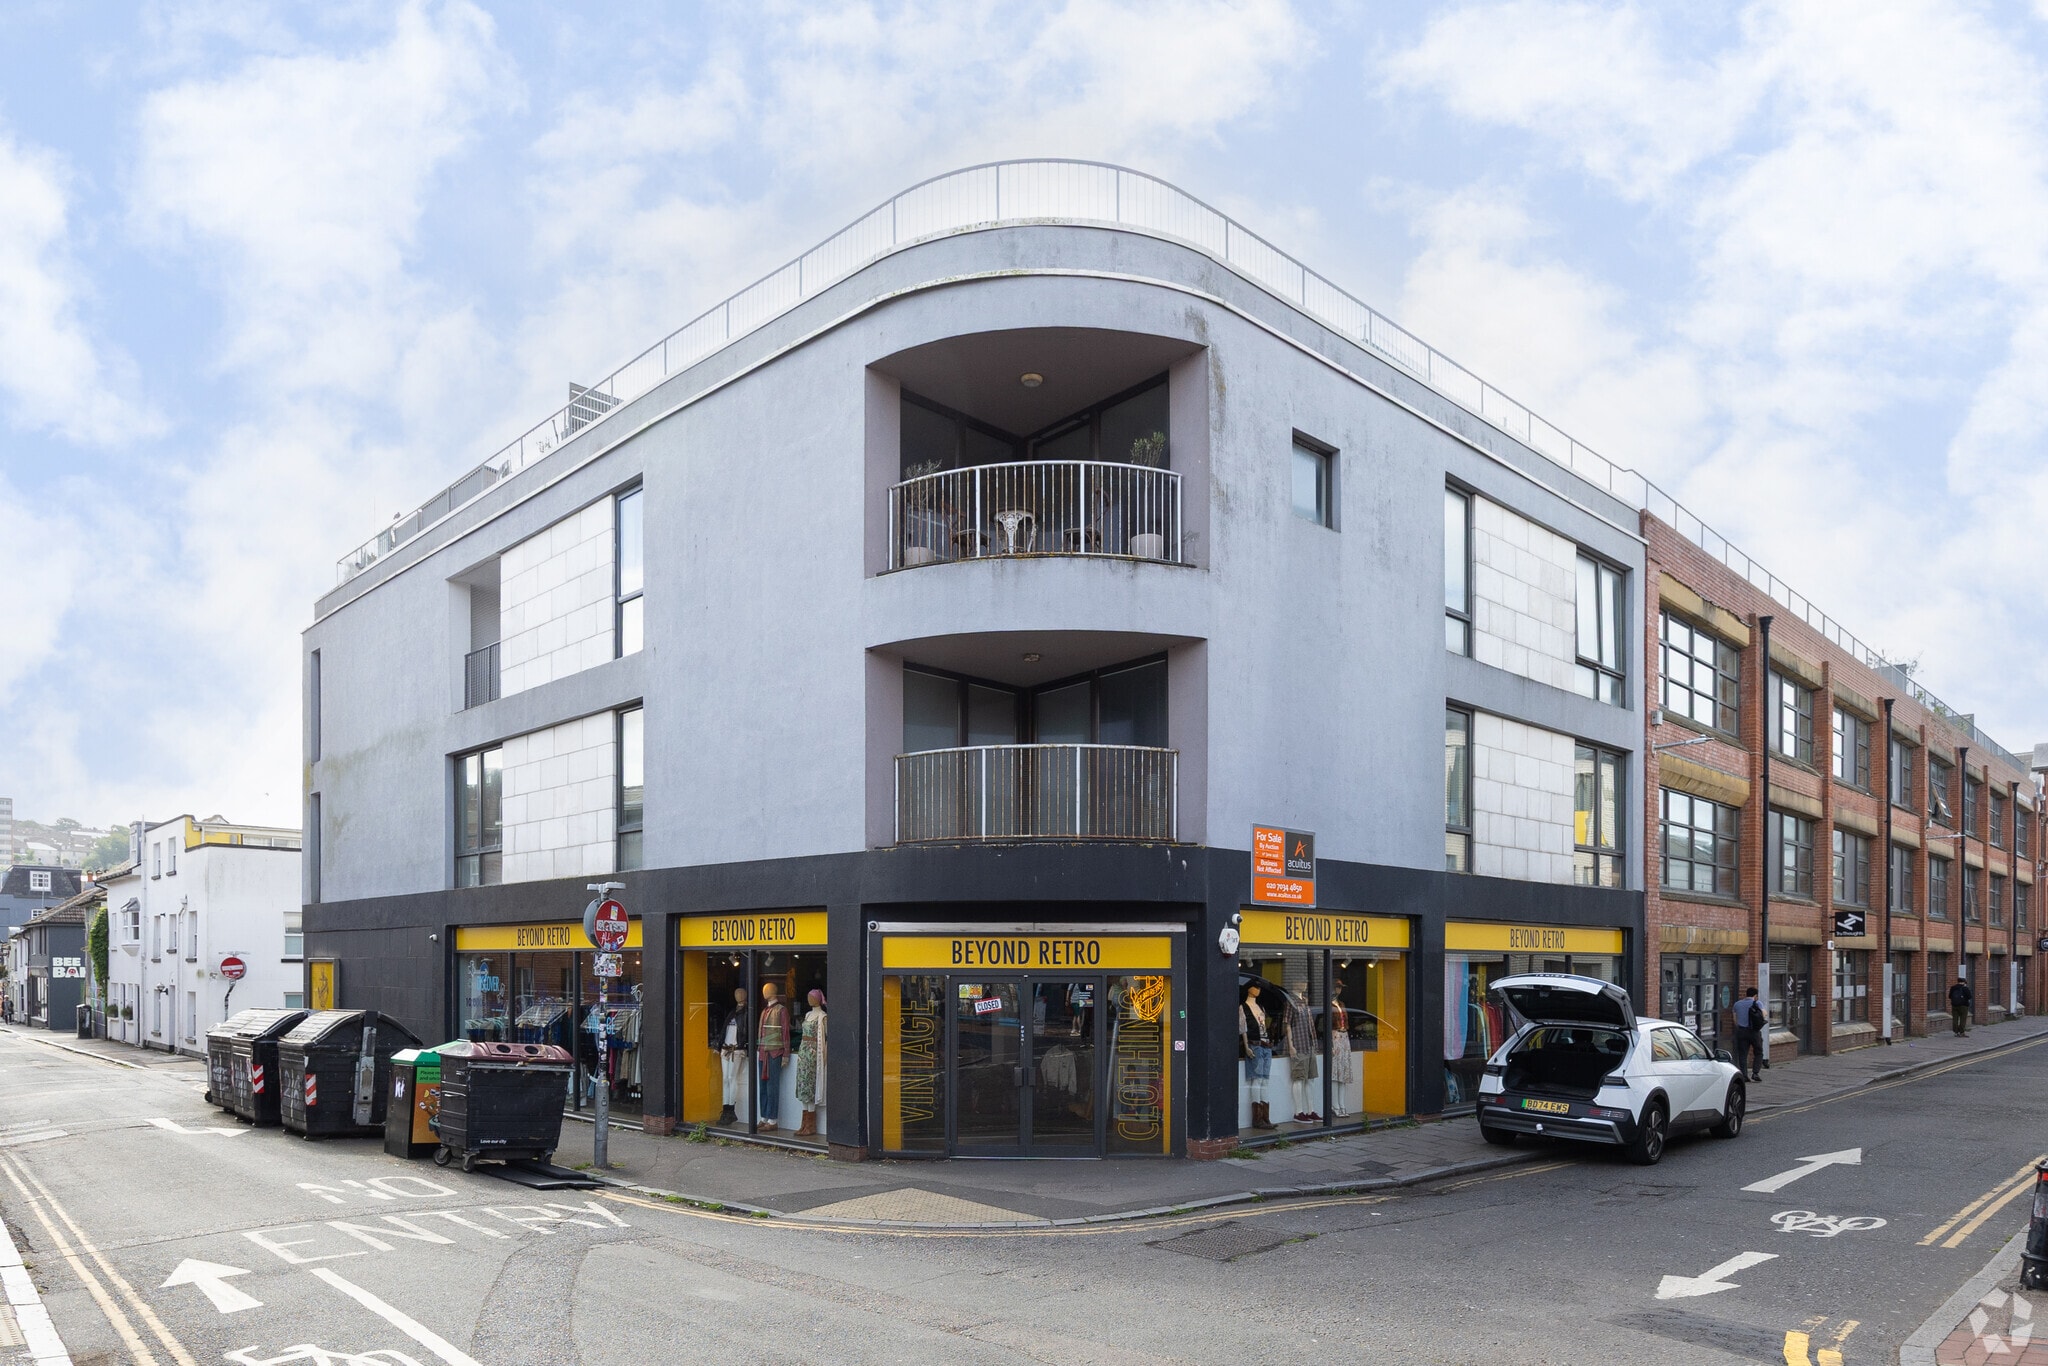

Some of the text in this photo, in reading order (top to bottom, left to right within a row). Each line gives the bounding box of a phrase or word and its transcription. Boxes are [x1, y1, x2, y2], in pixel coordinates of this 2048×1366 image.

[1256, 831, 1282, 843] For Sale
[1260, 859, 1278, 867] Business
[1287, 858, 1312, 870] acuitus
[1265, 866, 1282, 874] Affected
[1276, 883, 1289, 892] 7034
[1289, 883, 1303, 893] 4850
[712, 917, 796, 942] BEYOND RETRO
[1285, 915, 1369, 943] BEYOND RETRO
[517, 926, 571, 947] BEYOND RETRO
[1510, 928, 1565, 949] BEYOND RETRO
[952, 940, 1101, 965] BEYOND RETRO
[52, 956, 81, 967] BEE
[976, 999, 1000, 1012] CLOSED
[1526, 1099, 1569, 1112] BD74 EWS
[295, 1176, 458, 1204] NO
[240, 1201, 632, 1264] ENTRY
